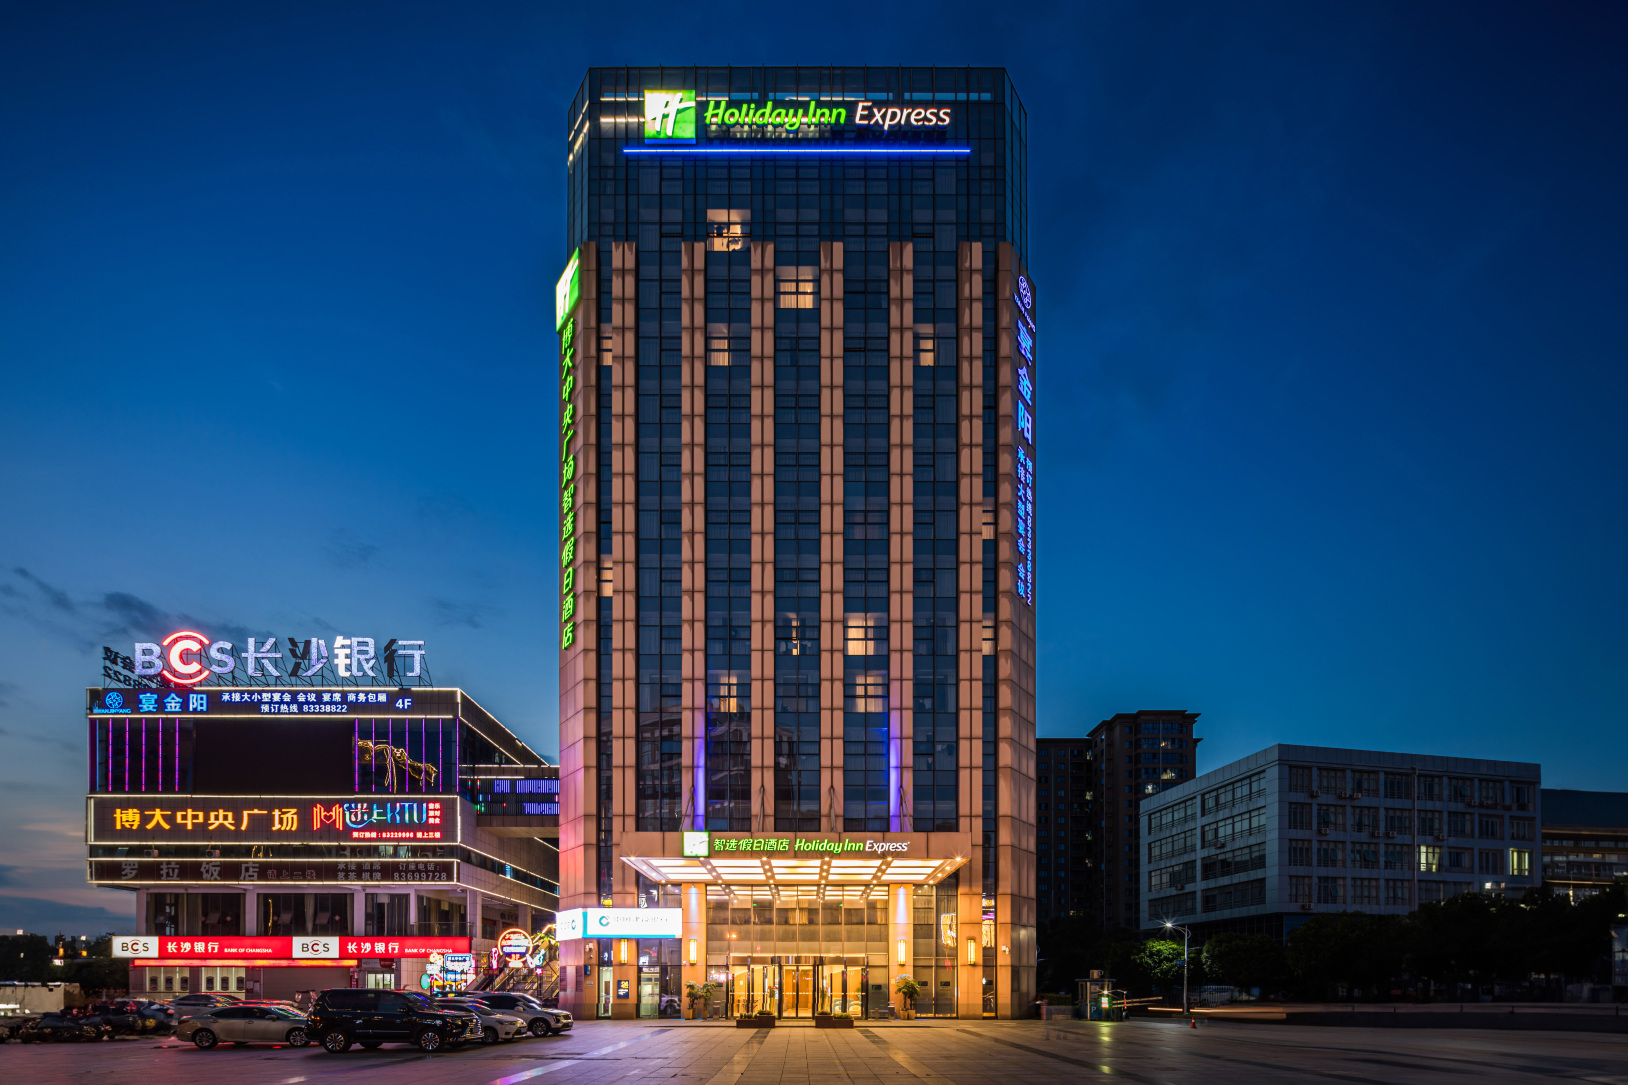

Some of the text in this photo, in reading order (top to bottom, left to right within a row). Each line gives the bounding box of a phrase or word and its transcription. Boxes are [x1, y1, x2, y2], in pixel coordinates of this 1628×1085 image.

[704, 100, 951, 130] Holiday Inn Express
[561, 317, 576, 650] 博大中央广场智选假日酒店
[134, 639, 236, 675] BCS
[241, 635, 426, 678] 长沙银行
[138, 692, 208, 713] 宴金阳
[221, 692, 387, 702] 承接大小型宴会 会议 宴席 商务包厢
[395, 698, 412, 709] 4F
[260, 704, 348, 713] 预订热线 83338822
[113, 808, 298, 832] 博大中央广场
[713, 838, 790, 852] 智选假日酒店
[794, 838, 909, 854] Holiday Inn Express
[121, 861, 260, 881] 罗拉饭店
[267, 869, 316, 880] 请上二楼
[393, 872, 447, 881] 83699728
[121, 941, 149, 952] BCS
[166, 941, 220, 953] 长沙银行
[301, 942, 330, 953] BCS
[347, 942, 400, 954] 长沙银行
